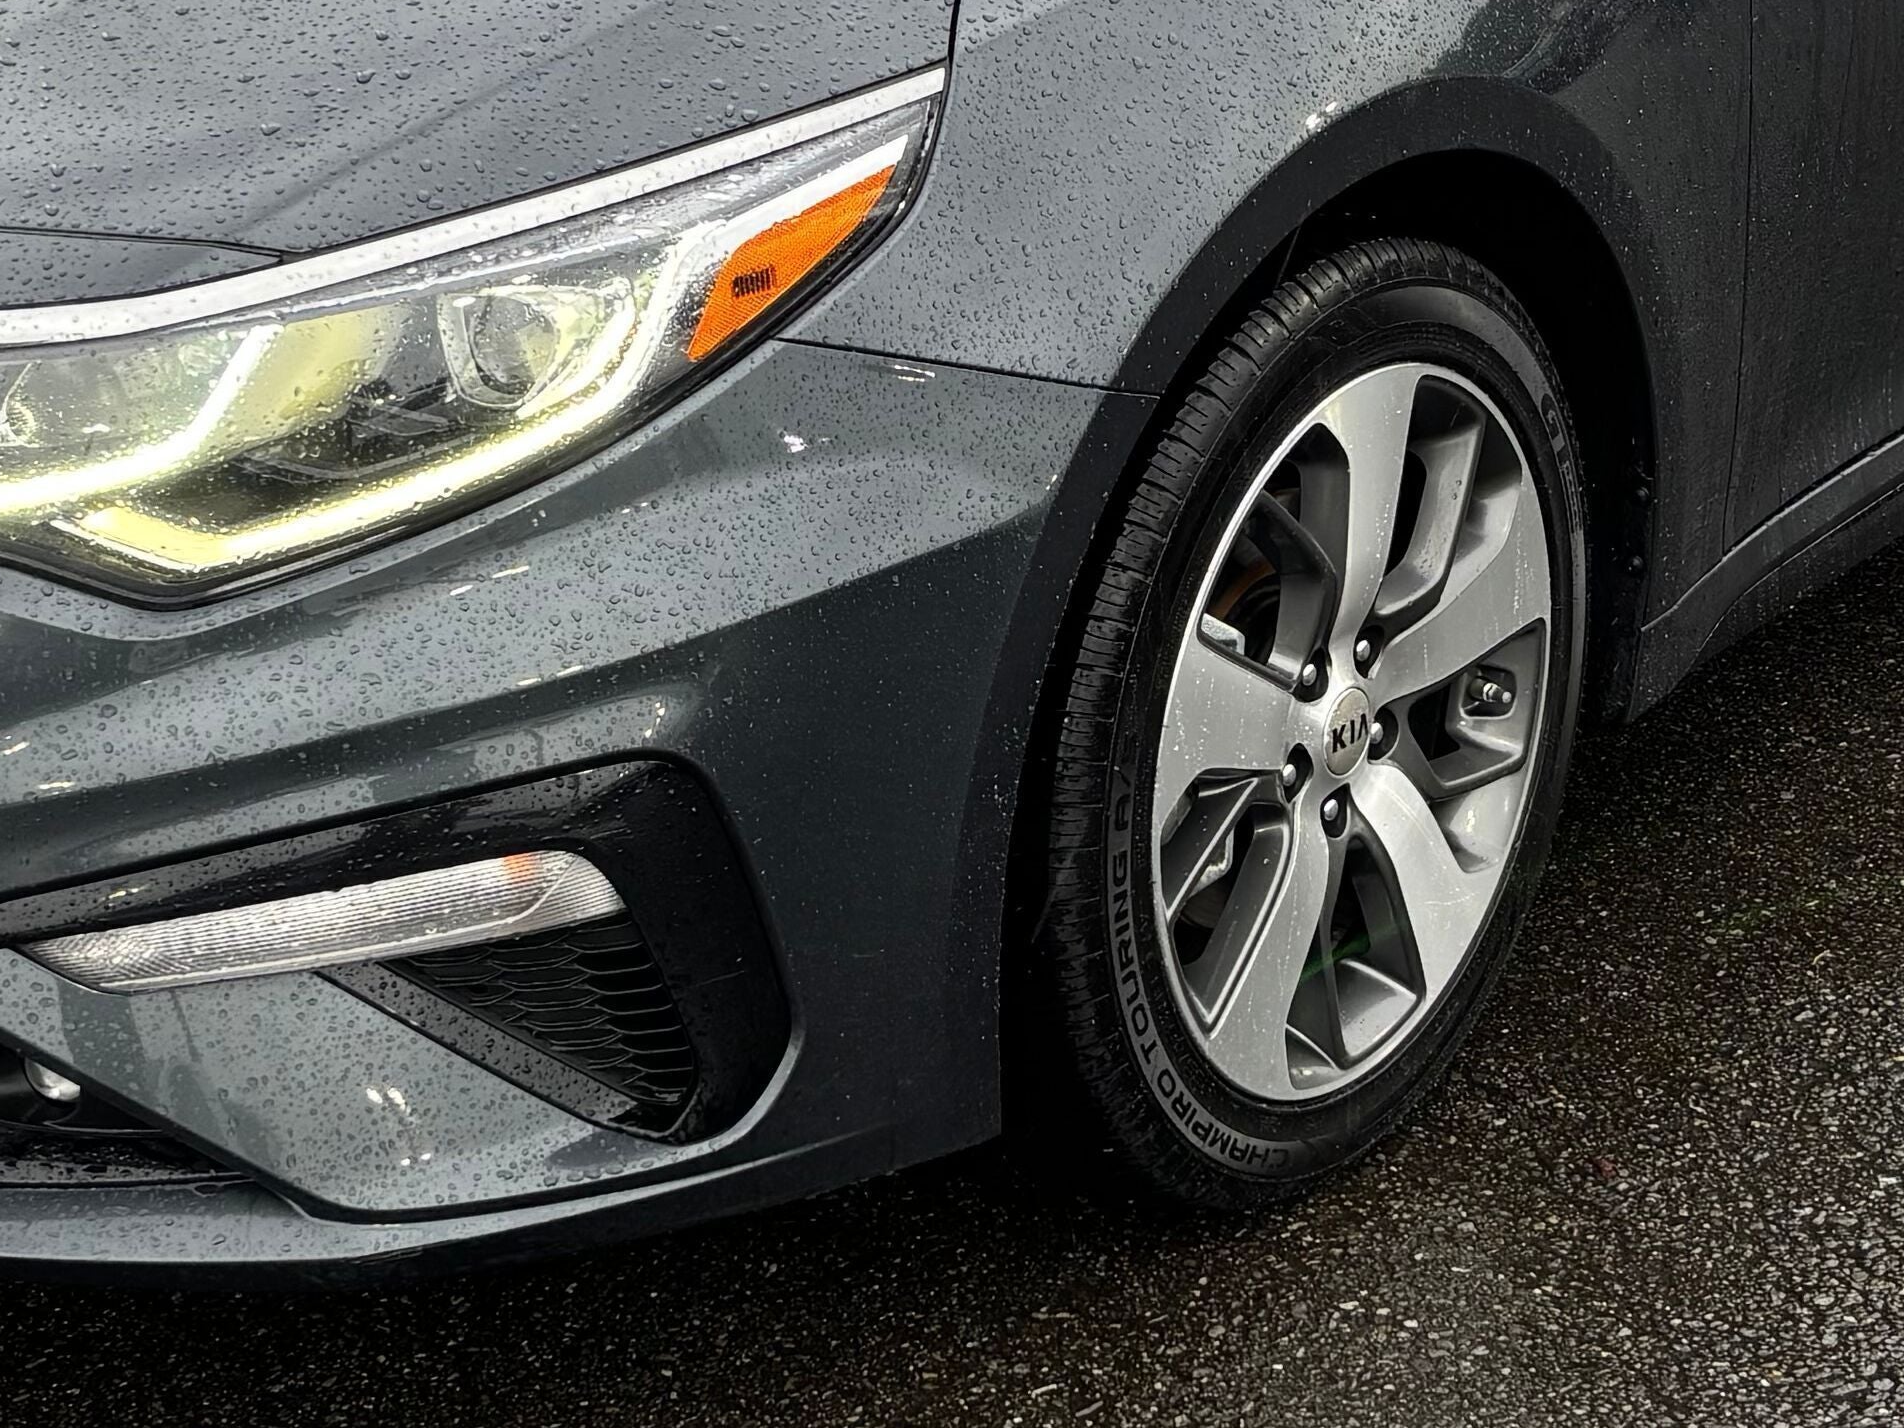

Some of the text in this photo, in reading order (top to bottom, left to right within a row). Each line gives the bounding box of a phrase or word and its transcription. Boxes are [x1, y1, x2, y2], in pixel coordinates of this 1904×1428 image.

[1332, 713, 1368, 754] KIA
[1112, 849, 1158, 1065] TOURING
[1156, 1067, 1290, 1170] CHAMPIRO
